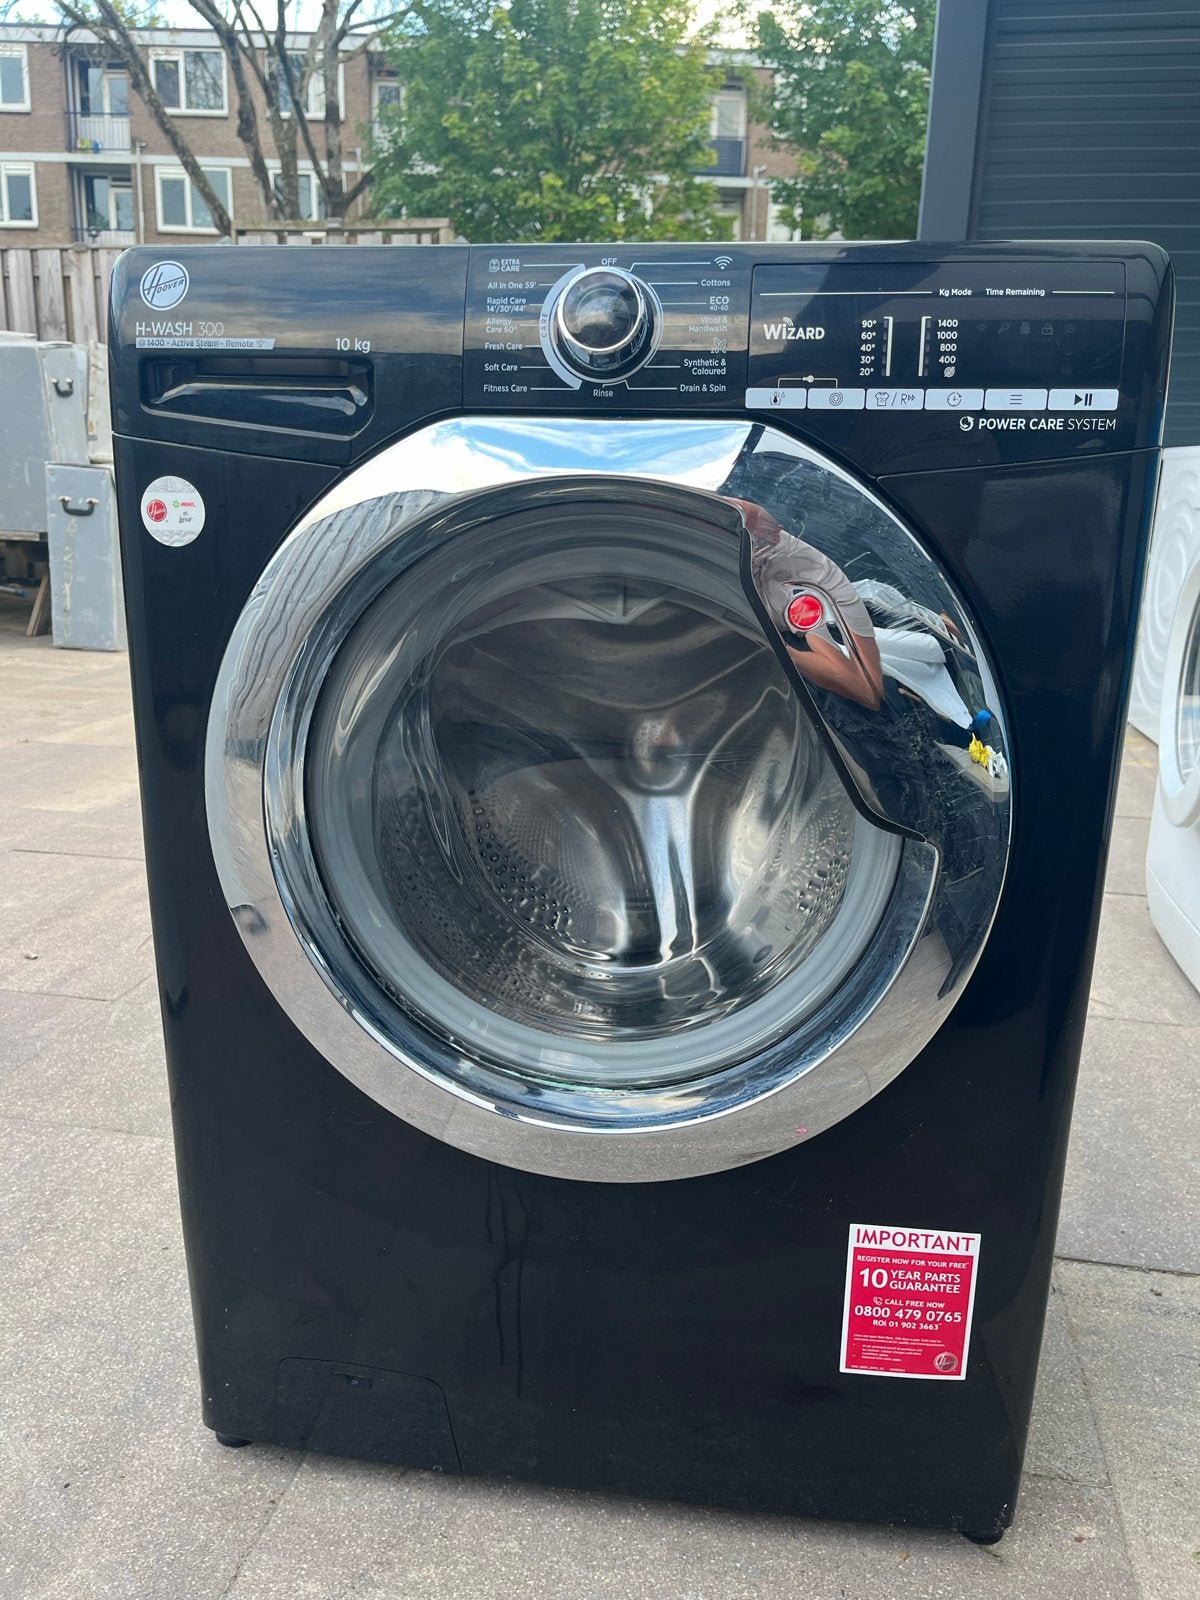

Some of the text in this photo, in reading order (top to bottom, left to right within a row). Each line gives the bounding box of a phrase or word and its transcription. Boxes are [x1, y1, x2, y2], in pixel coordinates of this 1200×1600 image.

[601, 258, 617, 266] OFF
[700, 279, 730, 287] Cottons
[1006, 288, 1046, 296] Remaining
[486, 296, 508, 305] Rapid
[710, 296, 730, 304] ECO
[486, 318, 512, 326] Allergy
[540, 312, 548, 338] CARE
[938, 320, 958, 328] 1400
[136, 322, 224, 336] H-WASH 300
[936, 332, 958, 340] 1000
[336, 338, 370, 354] 10 kg
[940, 344, 957, 352] 800
[683, 358, 726, 368] Synthetic &
[938, 356, 956, 364] 400
[484, 363, 518, 371] Soft Care
[692, 367, 726, 375] Coloured
[483, 384, 528, 392] Fitness Care
[680, 384, 726, 393] Drain & Spin
[592, 389, 614, 397] Rinse
[978, 418, 1116, 430] POWER CARE SYSTEM
[856, 1228, 976, 1252] IMPORTANT
[856, 1255, 890, 1264] REGISTER
[860, 1268, 888, 1288] 10
[890, 1270, 960, 1283] YEAR PARTS
[889, 1280, 960, 1294] GUARANTEE
[854, 1305, 962, 1322] 0800 479 0765
